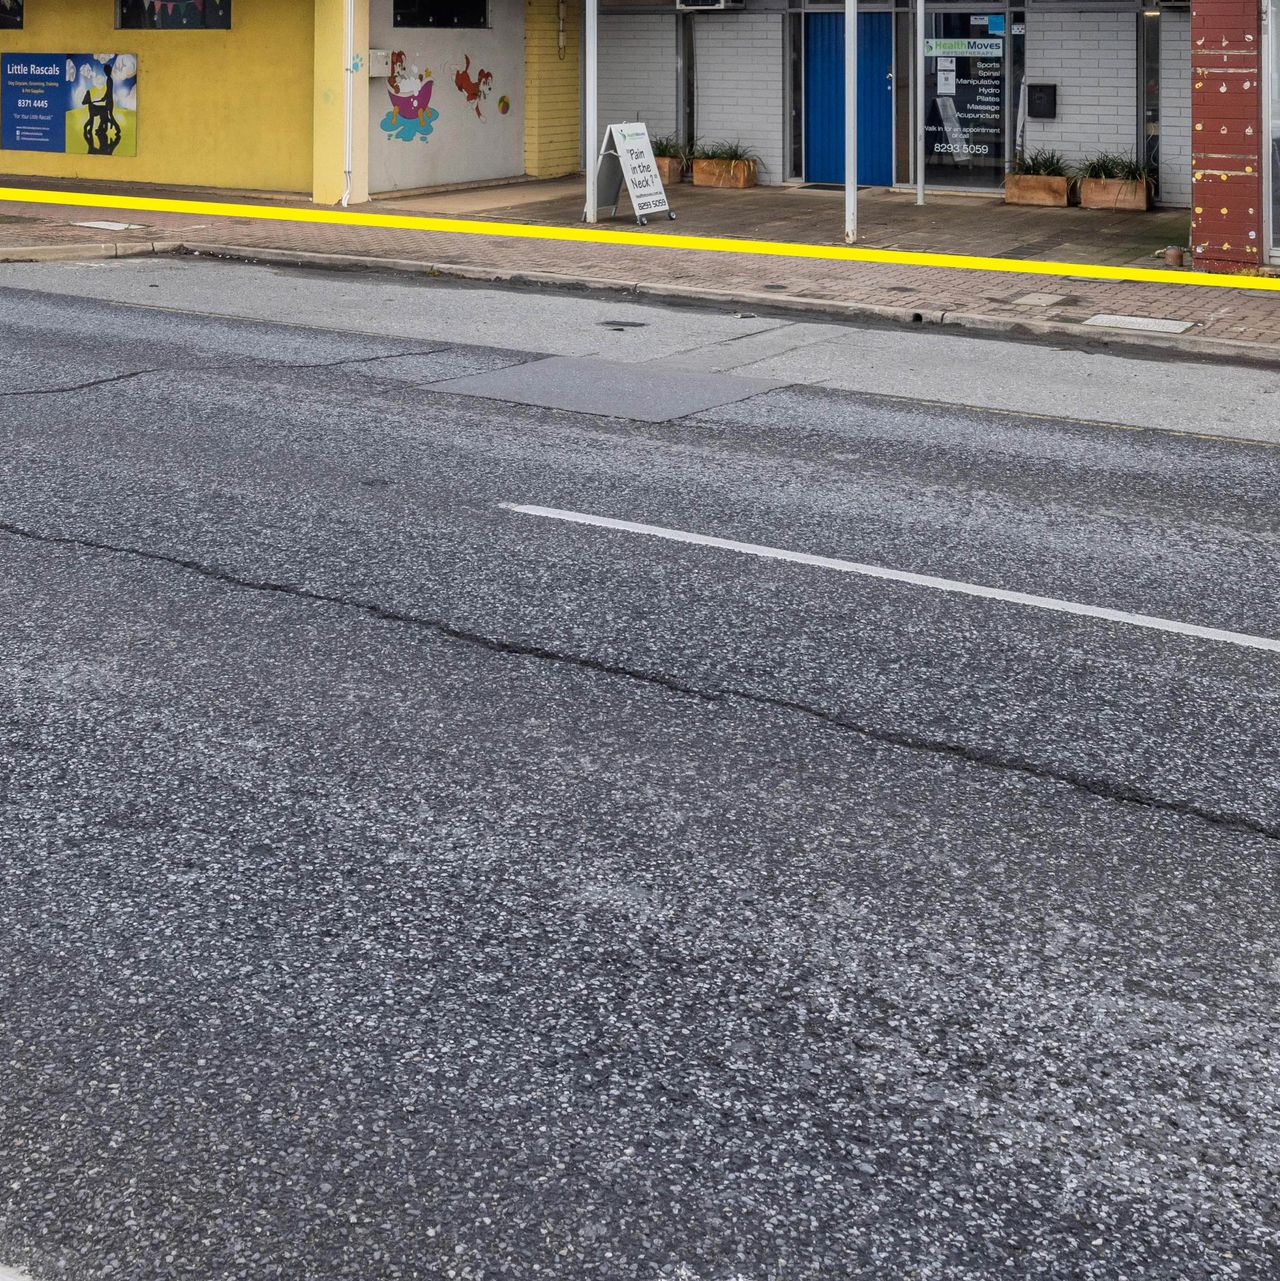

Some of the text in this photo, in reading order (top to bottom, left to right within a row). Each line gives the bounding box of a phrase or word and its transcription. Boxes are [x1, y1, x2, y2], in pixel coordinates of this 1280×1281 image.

[934, 40, 1001, 50] HealthMoves
[7, 64, 60, 75] Little Rascals
[955, 78, 1000, 86] Manipulative
[17, 99, 48, 108] 8371 4445
[934, 144, 989, 154] 8293 5059
[630, 162, 652, 175] in the
[630, 176, 650, 190] Neck
[637, 199, 667, 210] 8293 5059
